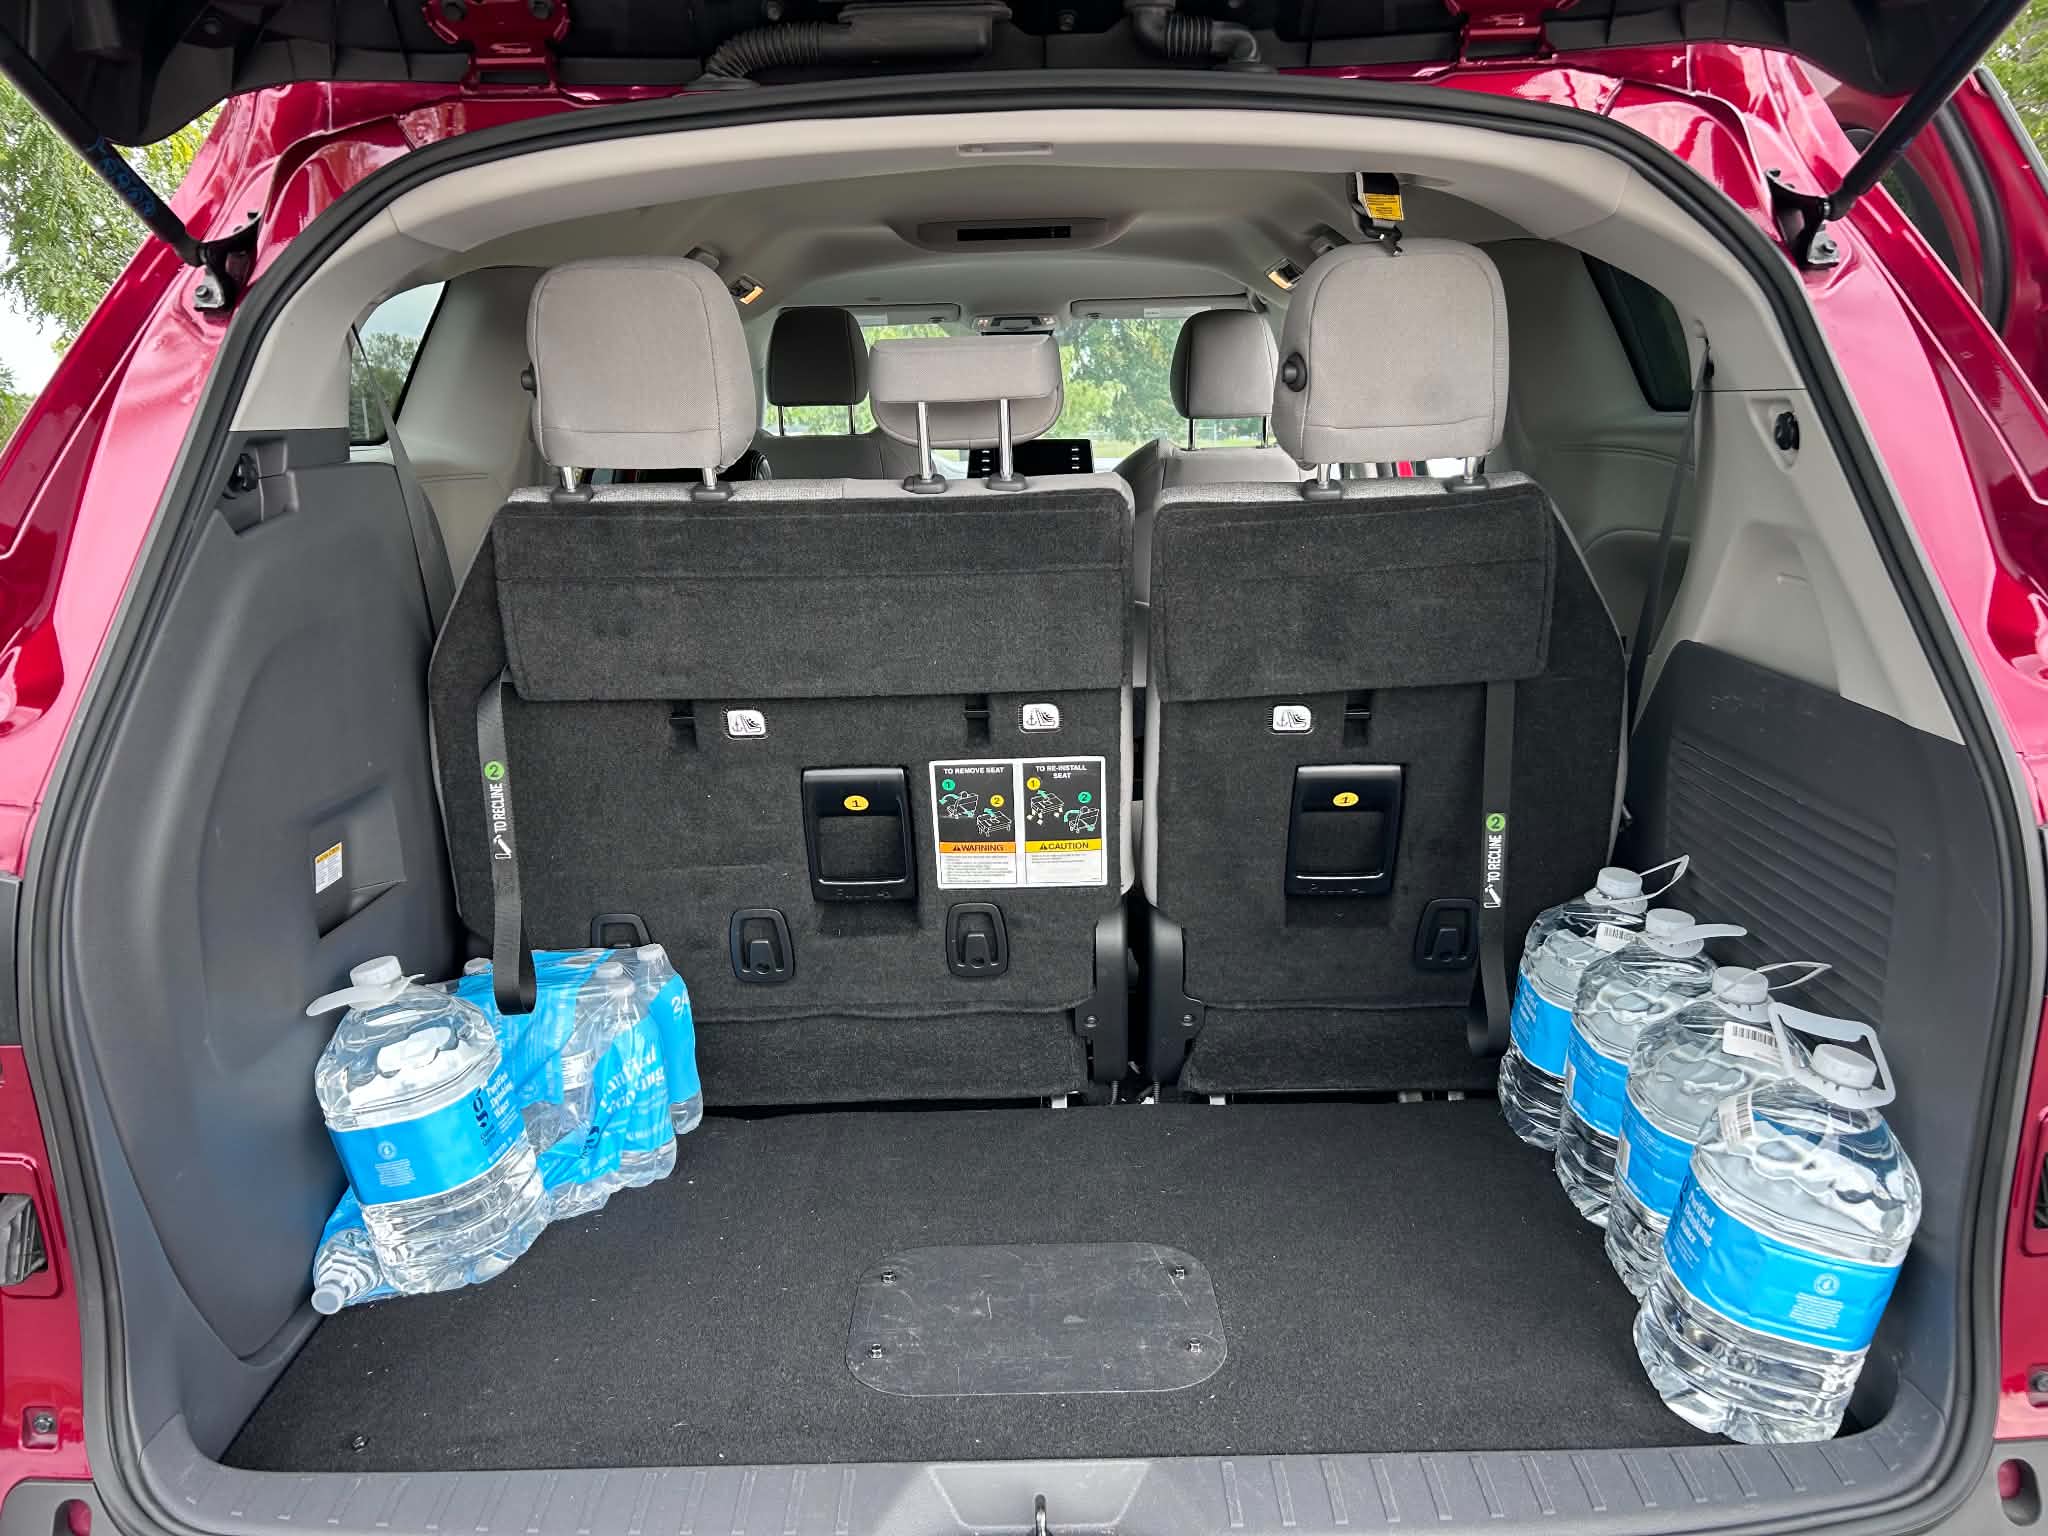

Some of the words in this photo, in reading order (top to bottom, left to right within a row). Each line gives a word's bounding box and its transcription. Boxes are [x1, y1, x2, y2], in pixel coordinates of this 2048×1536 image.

[489, 764, 499, 778] 2
[943, 767, 954, 775] TO
[955, 767, 984, 775] REMOVE
[985, 766, 1005, 774] SEAT
[1046, 764, 1088, 772] RE-INSTALL
[489, 782, 506, 821] RECLINE
[493, 820, 508, 834] TO
[1491, 815, 1501, 830] 2
[961, 843, 1004, 852] WARNING
[1048, 841, 1089, 850] CAUTION
[1487, 834, 1502, 871] RECLINE
[1487, 871, 1501, 883] TO
